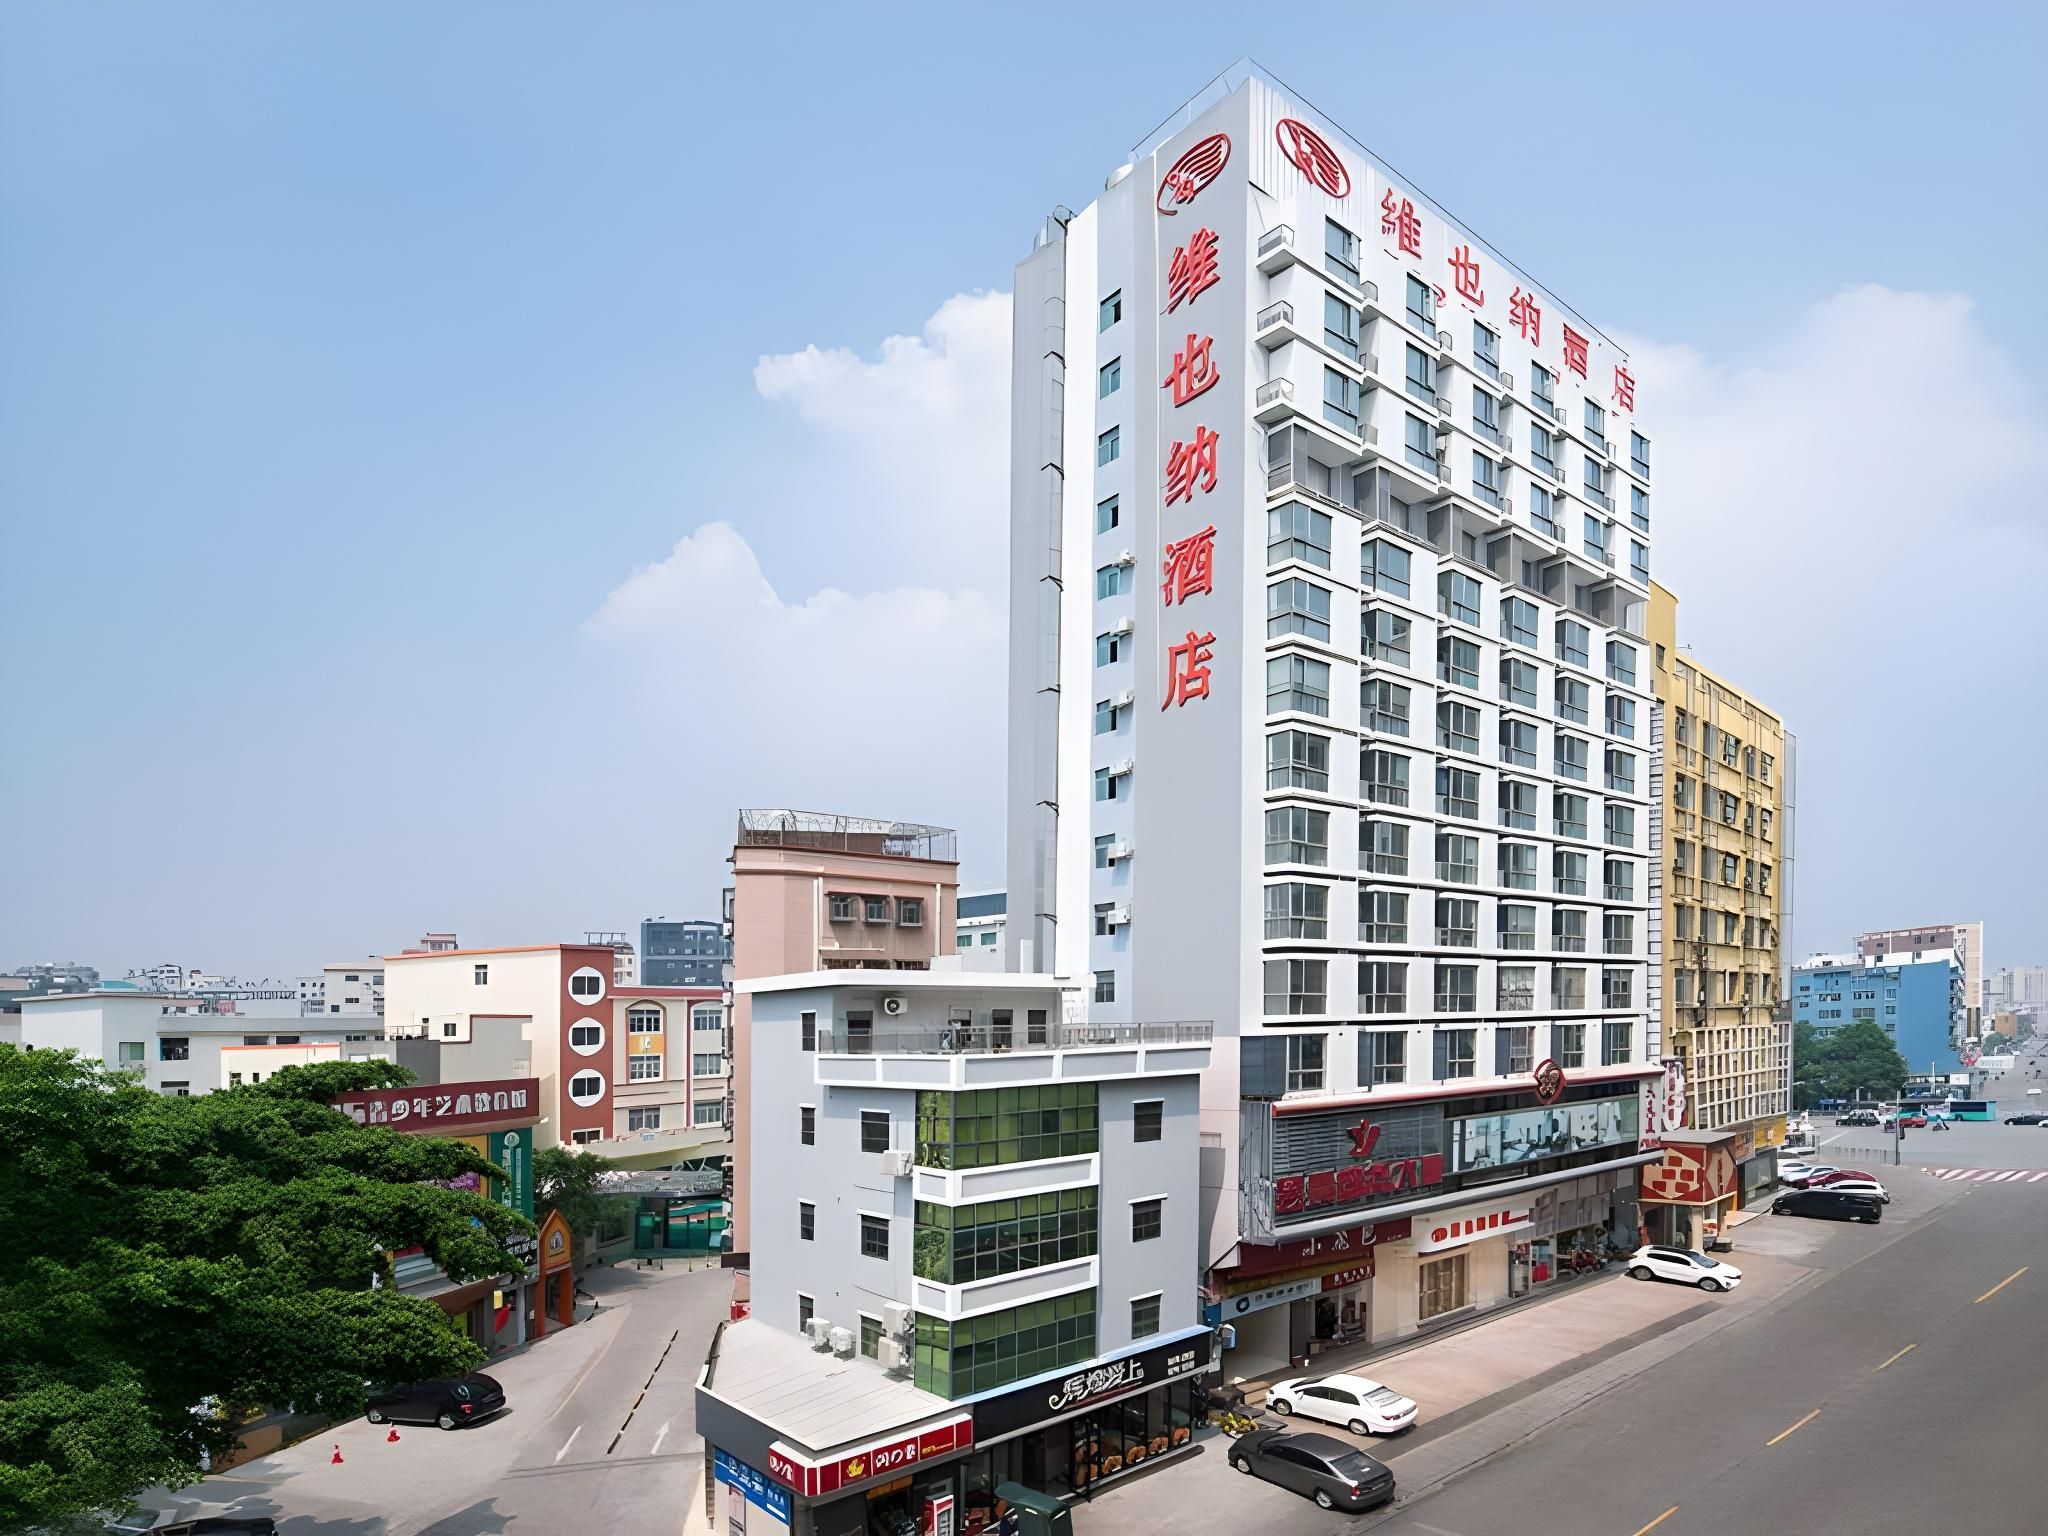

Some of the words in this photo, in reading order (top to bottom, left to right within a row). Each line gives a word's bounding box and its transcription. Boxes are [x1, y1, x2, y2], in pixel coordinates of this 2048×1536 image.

[1162, 226, 1220, 710] 维也纳酒店
